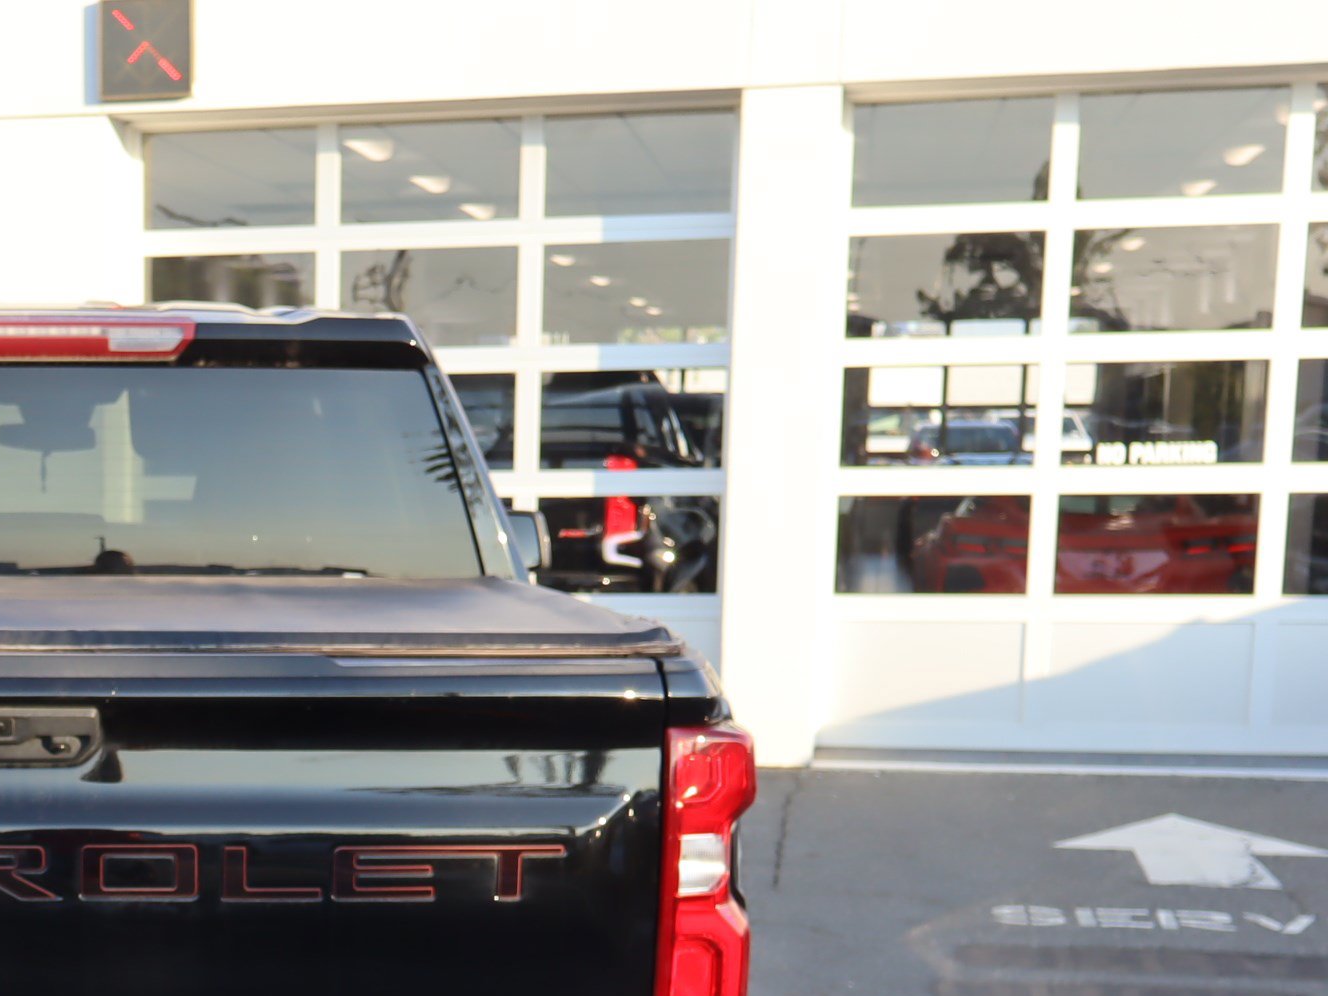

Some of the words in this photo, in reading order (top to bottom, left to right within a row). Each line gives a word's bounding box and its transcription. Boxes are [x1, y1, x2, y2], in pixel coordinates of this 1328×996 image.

[1096, 441, 1126, 465] NO
[1128, 440, 1217, 464] PARKING
[990, 905, 1317, 935] SERV
